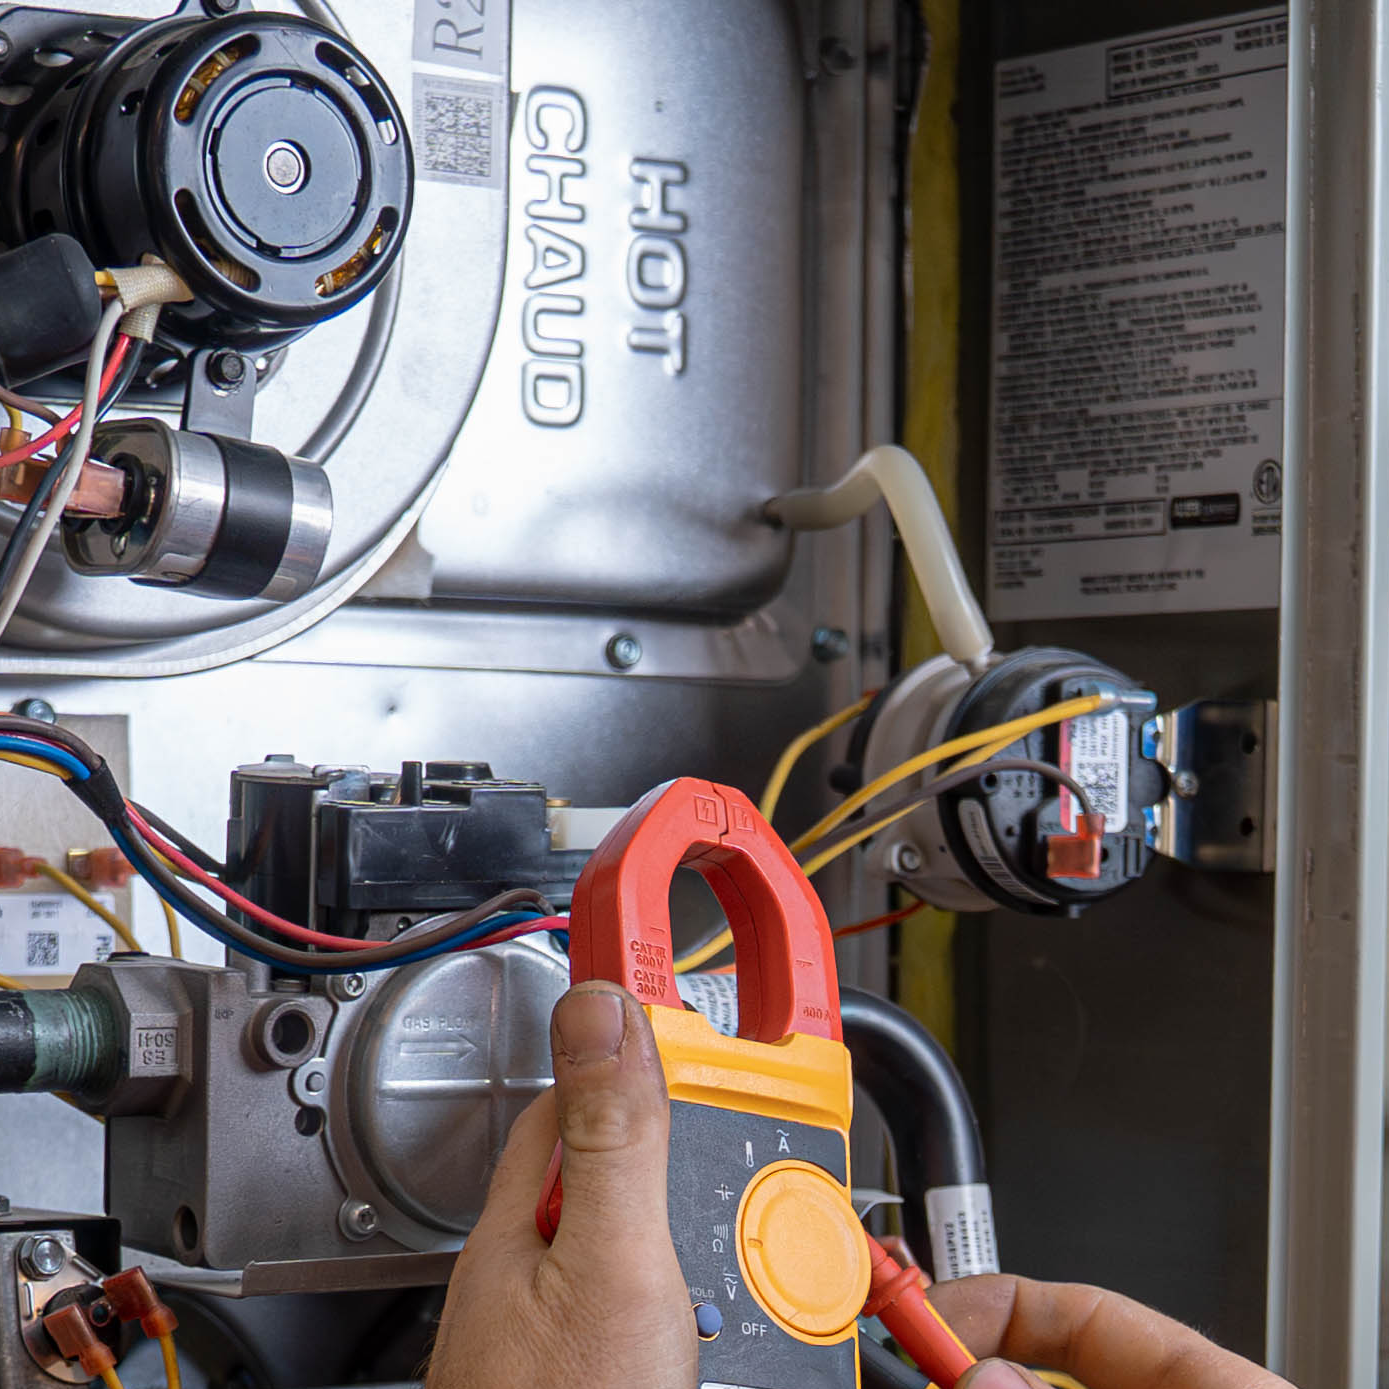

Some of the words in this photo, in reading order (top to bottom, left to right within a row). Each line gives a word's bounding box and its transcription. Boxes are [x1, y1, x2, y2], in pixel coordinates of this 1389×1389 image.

[522, 84, 588, 429] CHAUD
[626, 157, 689, 376] HOT
[631, 940, 652, 955] CAT
[634, 969, 656, 984] CAT
[402, 1015, 431, 1032] GAS
[741, 1322, 768, 1337] OFF
